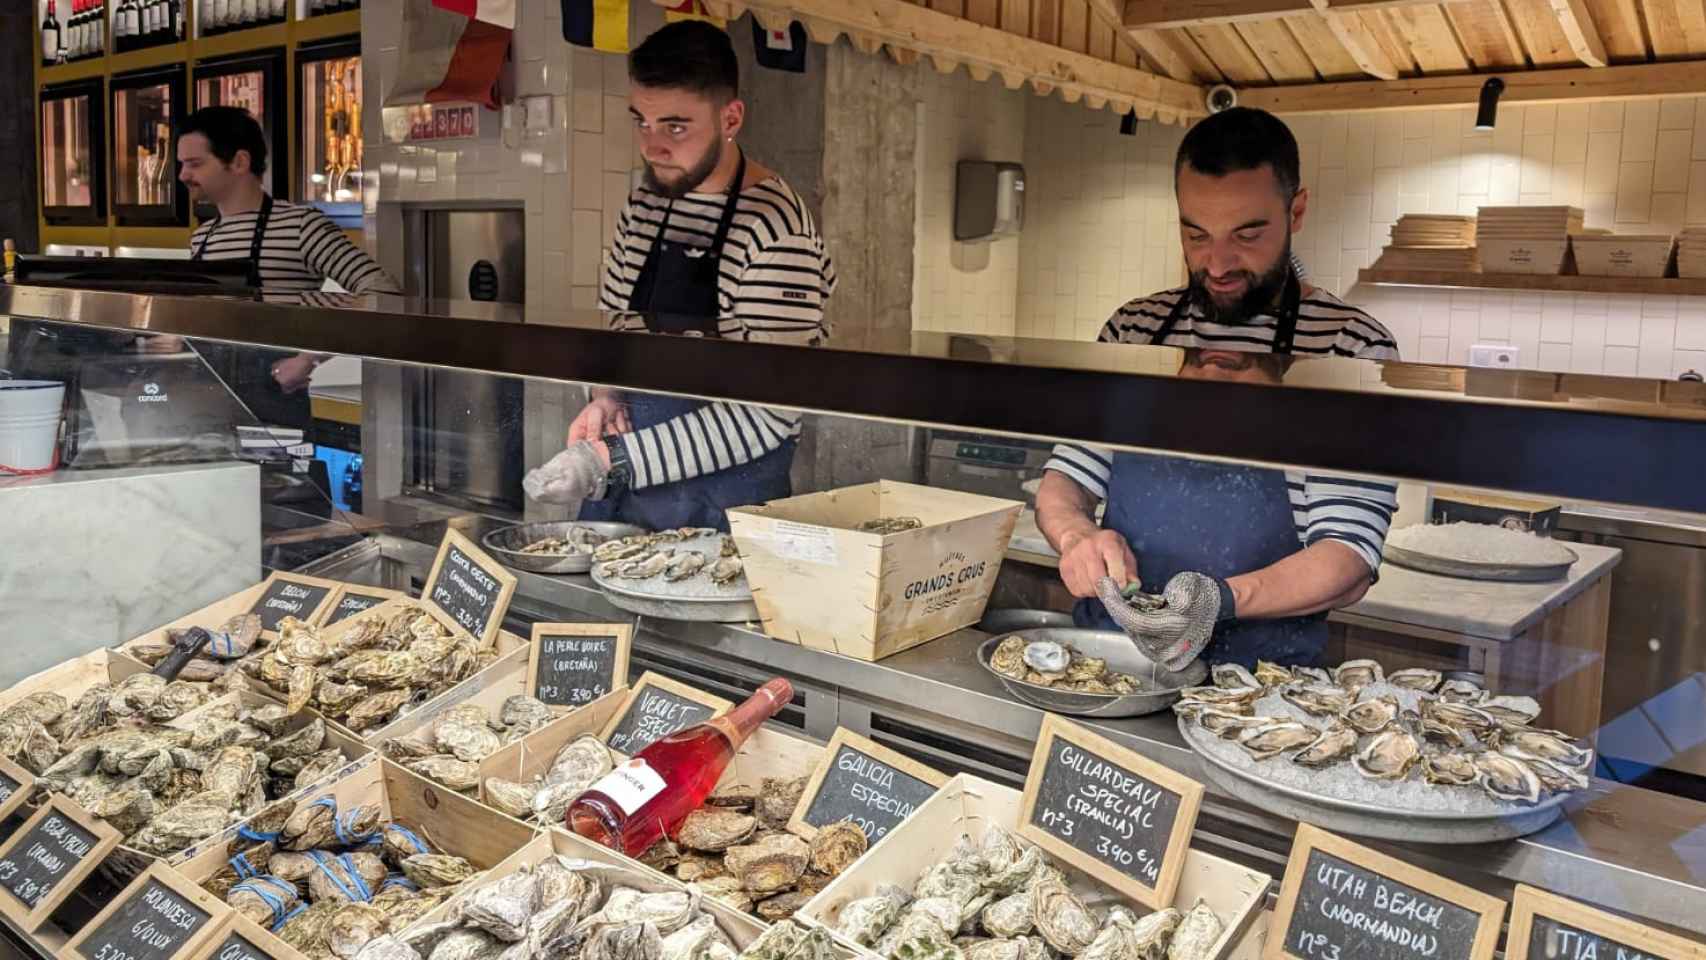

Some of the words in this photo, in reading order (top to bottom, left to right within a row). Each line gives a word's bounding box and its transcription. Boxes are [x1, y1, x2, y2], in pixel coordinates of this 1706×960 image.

[904, 571, 954, 600] GRANDS
[957, 560, 986, 584] CRUS
[544, 639, 554, 654] LA
[640, 691, 699, 723] VERNET
[838, 752, 895, 792] GALICIA
[1060, 745, 1162, 809] GILLARDEAU
[1066, 794, 1134, 840] (FRANCIA)
[1080, 784, 1154, 828] SPECIAL
[142, 886, 197, 931] HOLANDESA
[1316, 863, 1369, 900] UTAH
[1373, 884, 1445, 930] BEACH
[1320, 896, 1439, 957] (NORMANDIA)
[1555, 928, 1598, 960] TIA
